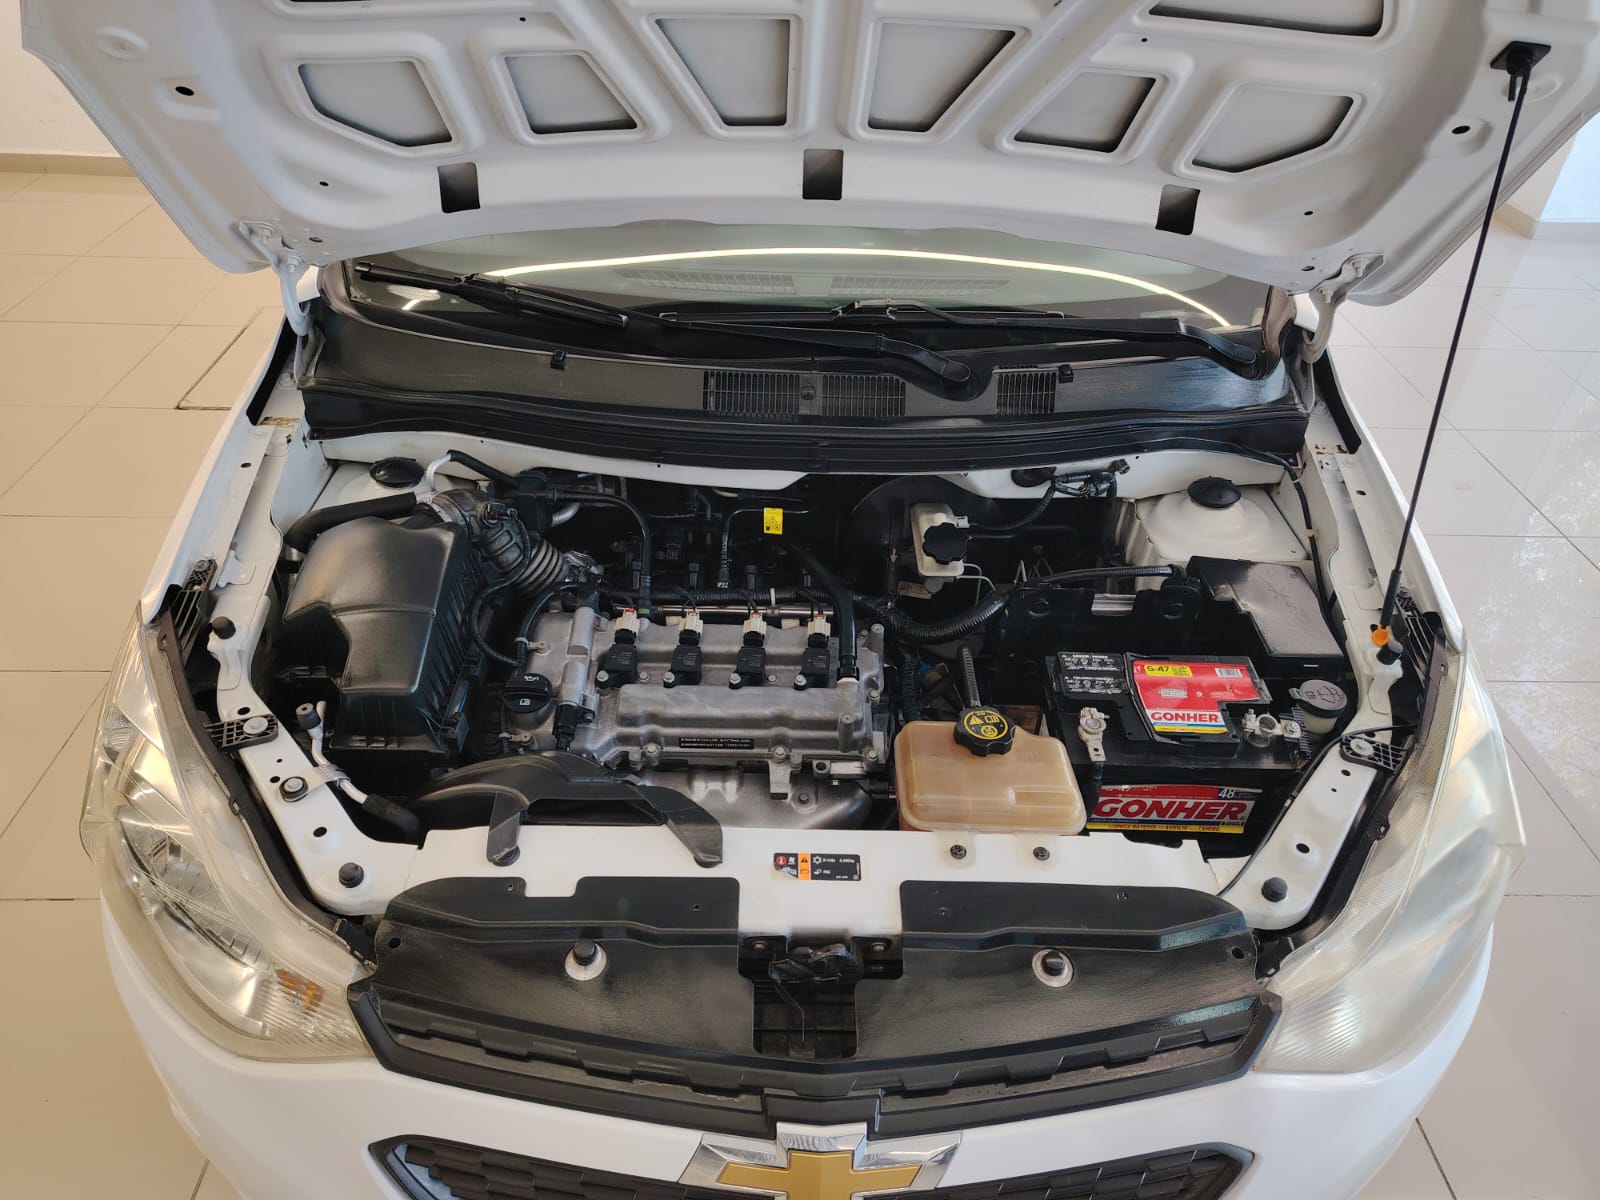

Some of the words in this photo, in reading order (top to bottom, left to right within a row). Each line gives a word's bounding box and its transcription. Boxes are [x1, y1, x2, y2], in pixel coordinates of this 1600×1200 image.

[1151, 712, 1219, 722] GONHER
[1218, 788, 1236, 799] 48
[1093, 799, 1246, 820] GONHER
